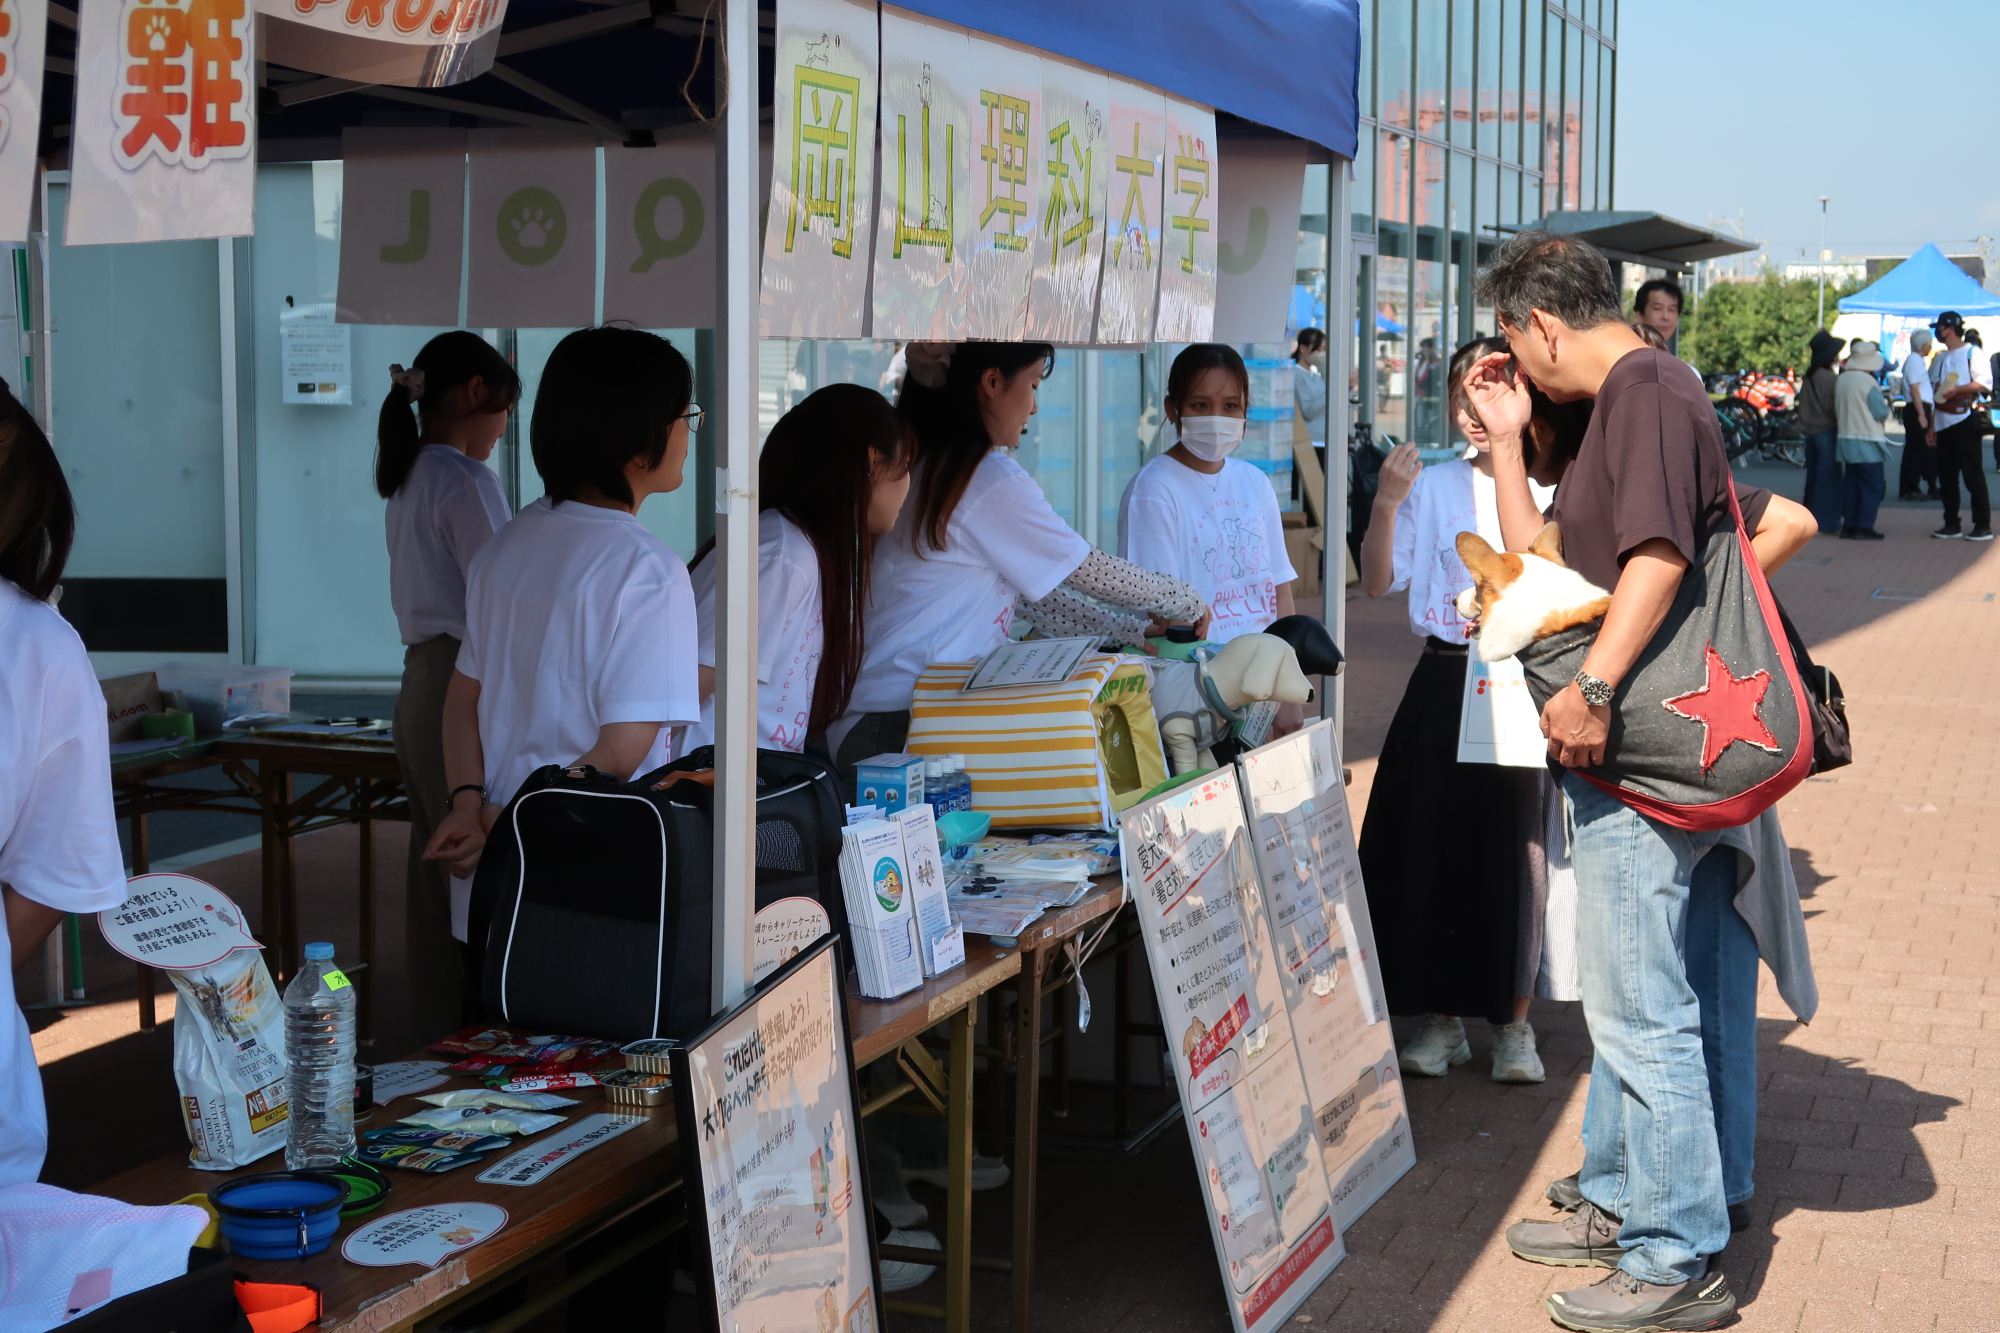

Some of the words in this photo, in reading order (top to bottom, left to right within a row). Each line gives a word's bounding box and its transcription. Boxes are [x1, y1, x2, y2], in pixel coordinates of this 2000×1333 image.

[784, 64, 1210, 282] 岡山理科大学
[334, 972, 346, 986] 水
[236, 1053, 278, 1077] VETERINARY
[252, 1068, 273, 1083] DIETS
[188, 1098, 199, 1117] NF
[218, 1103, 228, 1122] PRO
[248, 1093, 266, 1116] NF
[204, 1117, 215, 1142] DIETS
[209, 1099, 227, 1156] VETERINARY
[222, 1121, 234, 1149] PLAN
